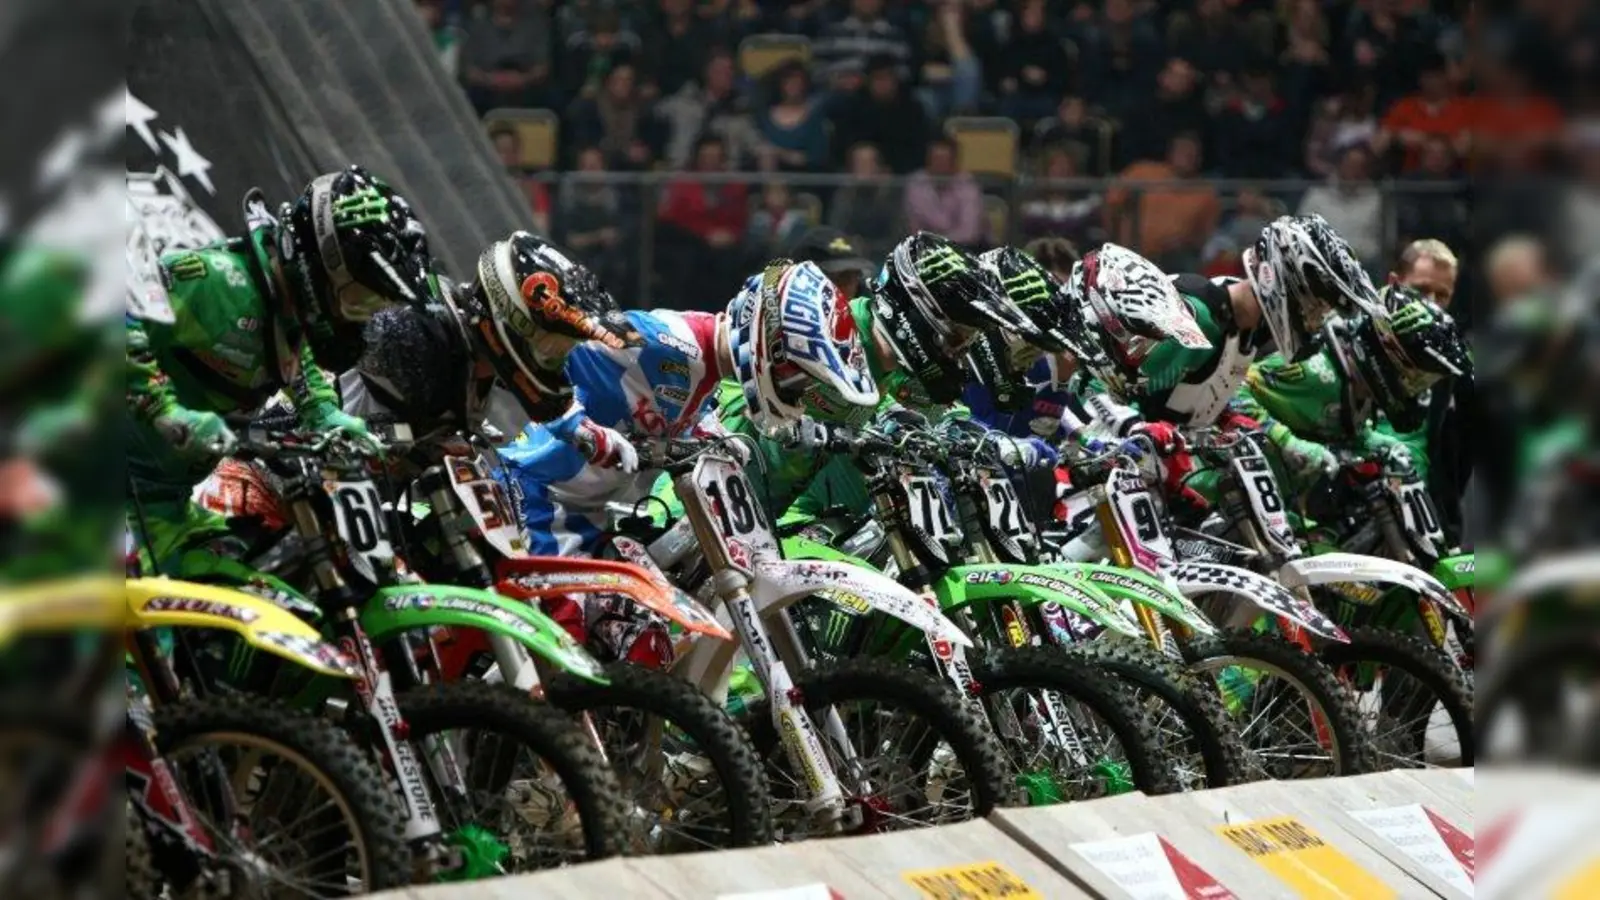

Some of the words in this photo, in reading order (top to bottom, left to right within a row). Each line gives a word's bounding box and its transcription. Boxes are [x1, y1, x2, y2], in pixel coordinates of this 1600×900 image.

[1253, 475, 1281, 512] 8
[1403, 489, 1439, 535] 10
[1132, 498, 1159, 541] 9
[966, 571, 995, 584] elf
